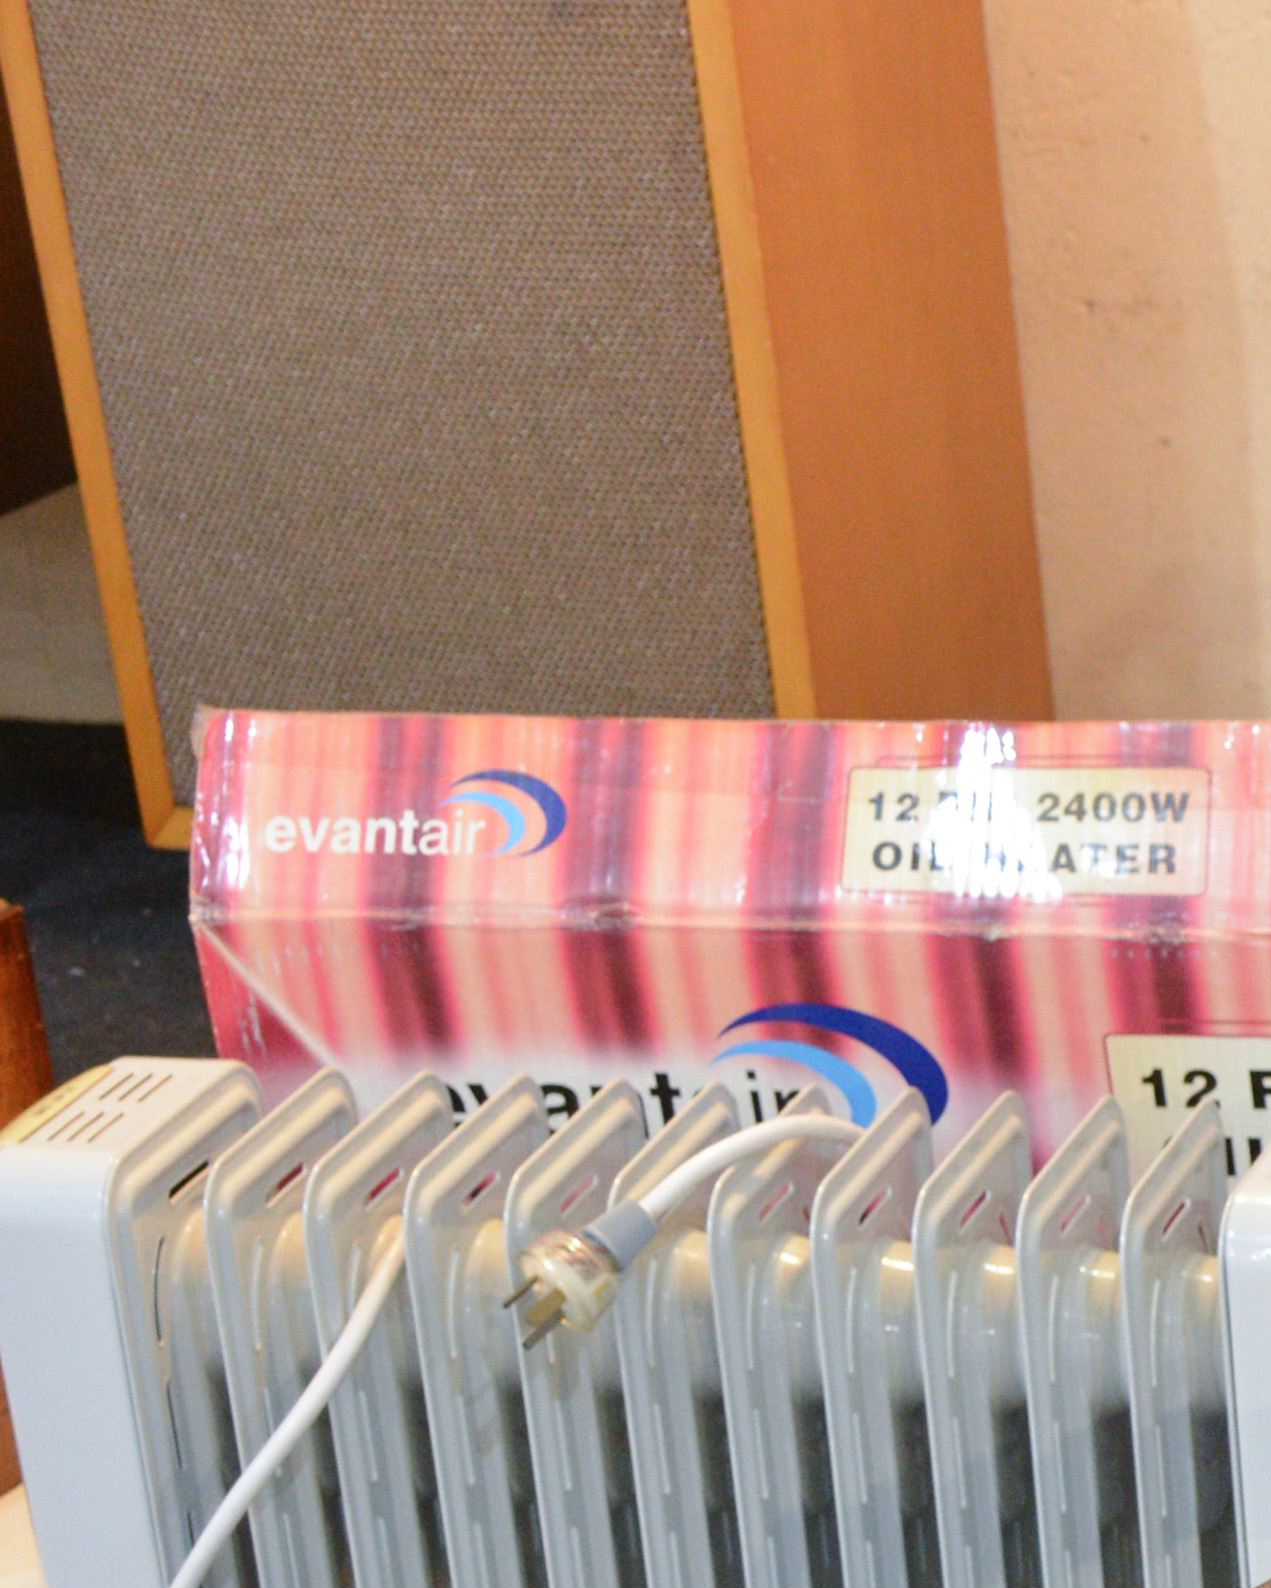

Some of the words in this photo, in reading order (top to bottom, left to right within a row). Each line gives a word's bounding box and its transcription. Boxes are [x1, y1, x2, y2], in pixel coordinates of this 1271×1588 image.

[868, 791, 921, 822] 12
[1036, 791, 1190, 823] 2400W
[264, 807, 488, 856] evantair
[1142, 1067, 1220, 1109] 12
